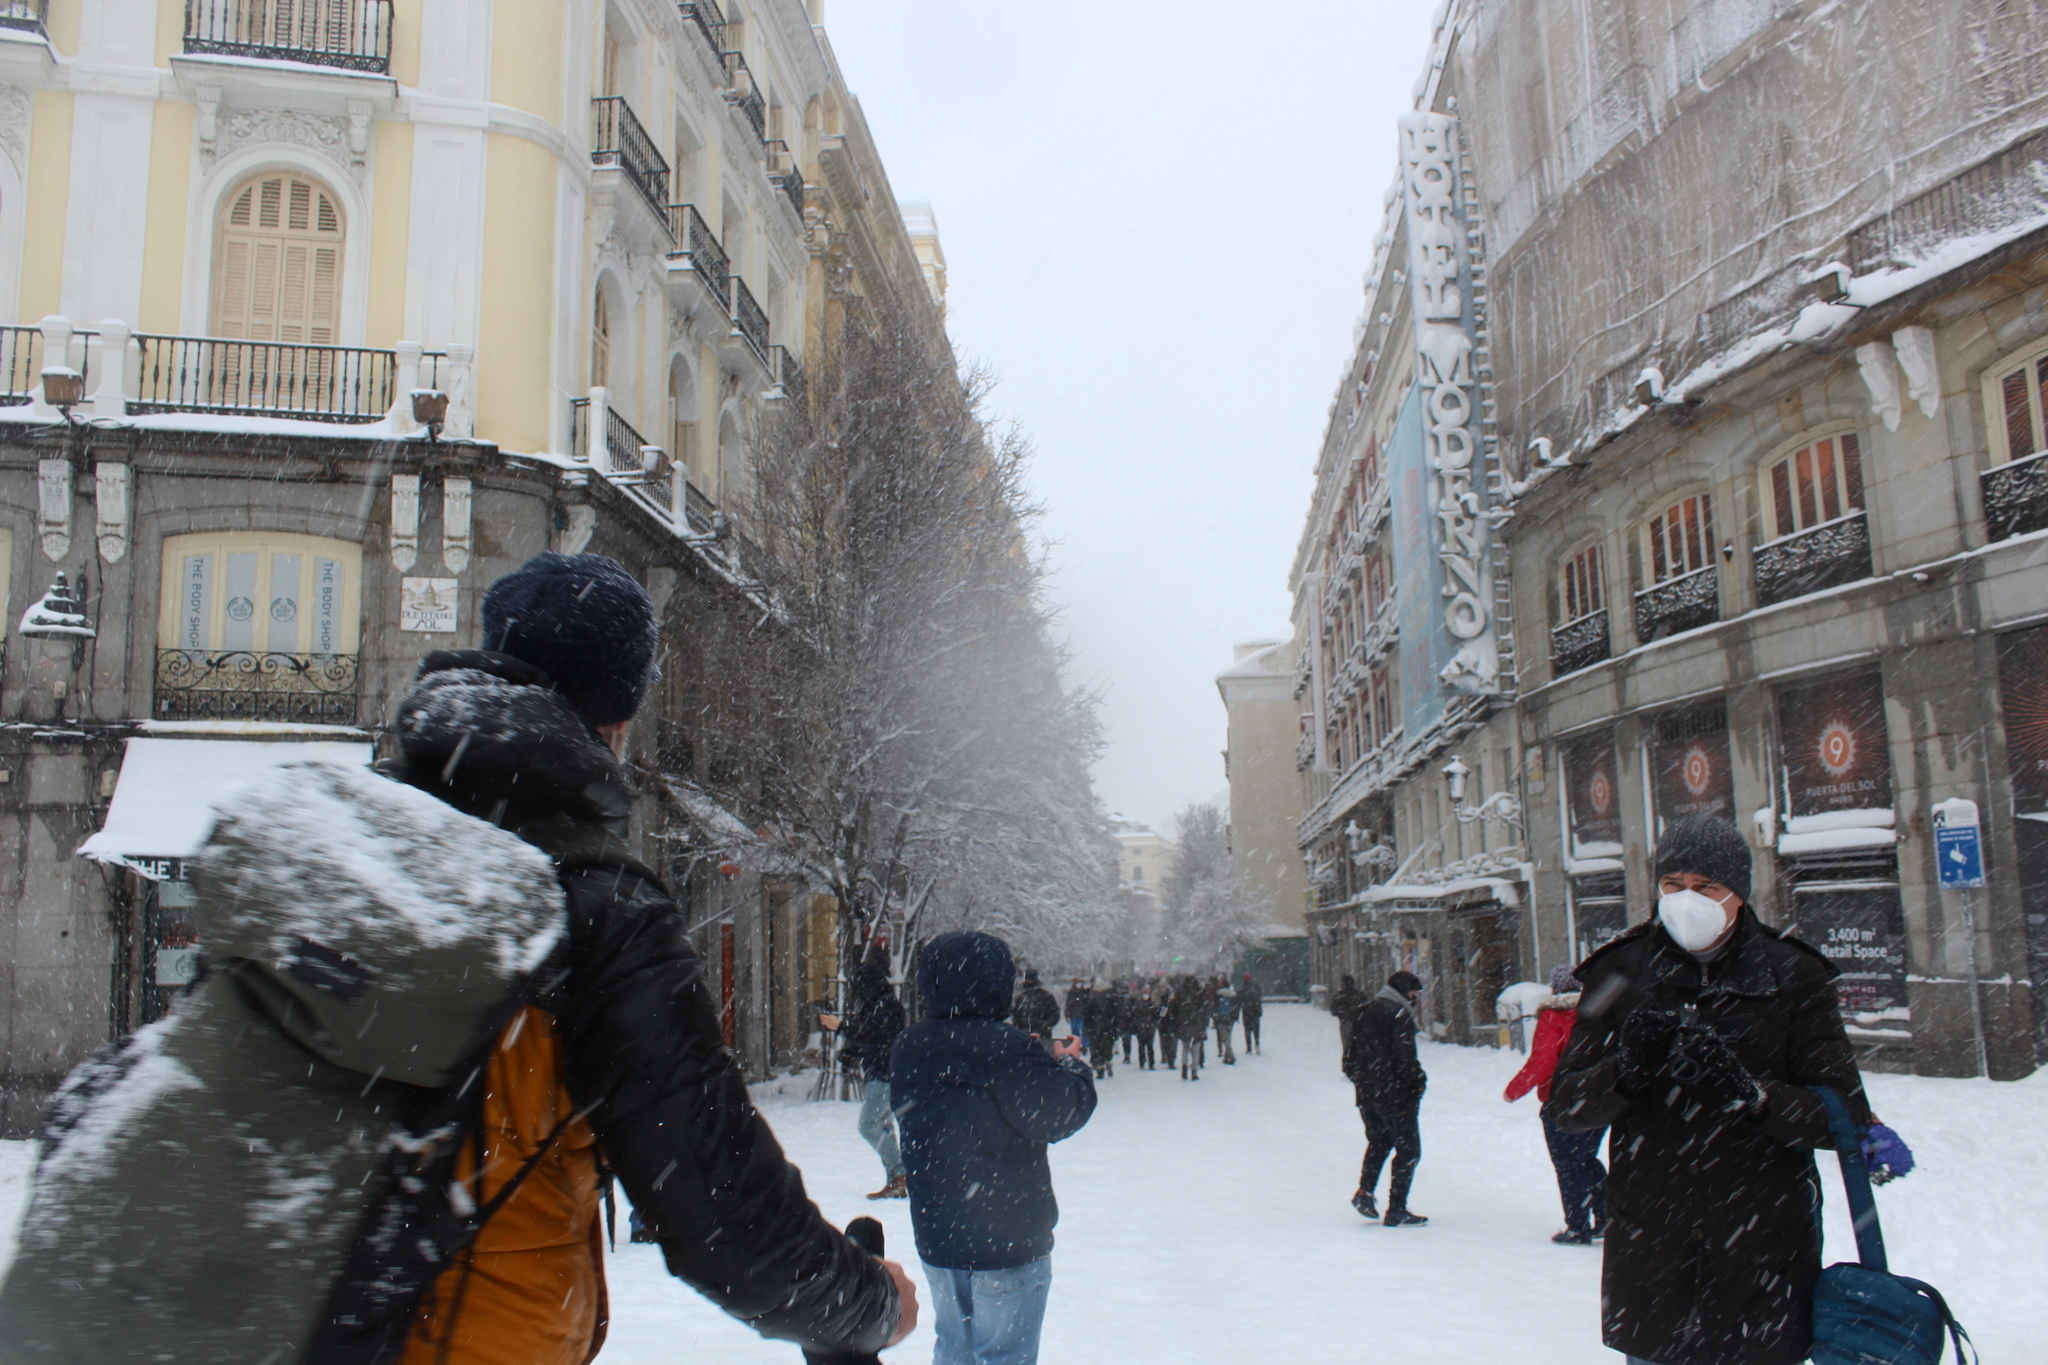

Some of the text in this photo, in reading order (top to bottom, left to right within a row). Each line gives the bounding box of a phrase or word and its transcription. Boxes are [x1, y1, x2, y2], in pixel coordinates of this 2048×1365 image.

[1406, 115, 1461, 320] HOTEL
[1420, 330, 1486, 640] MODERNO
[192, 557, 203, 579] THE
[190, 583, 202, 614] BODY
[320, 561, 334, 651] THE BODY SHOP
[1829, 737, 1843, 763] 9
[1691, 760, 1702, 784] 9
[1806, 779, 1876, 797] PUERTA DEL SOL
[132, 860, 170, 880] HE
[1828, 928, 1859, 942] 3,400
[1820, 943, 1852, 958] Retail
[1853, 944, 1887, 961] Space
